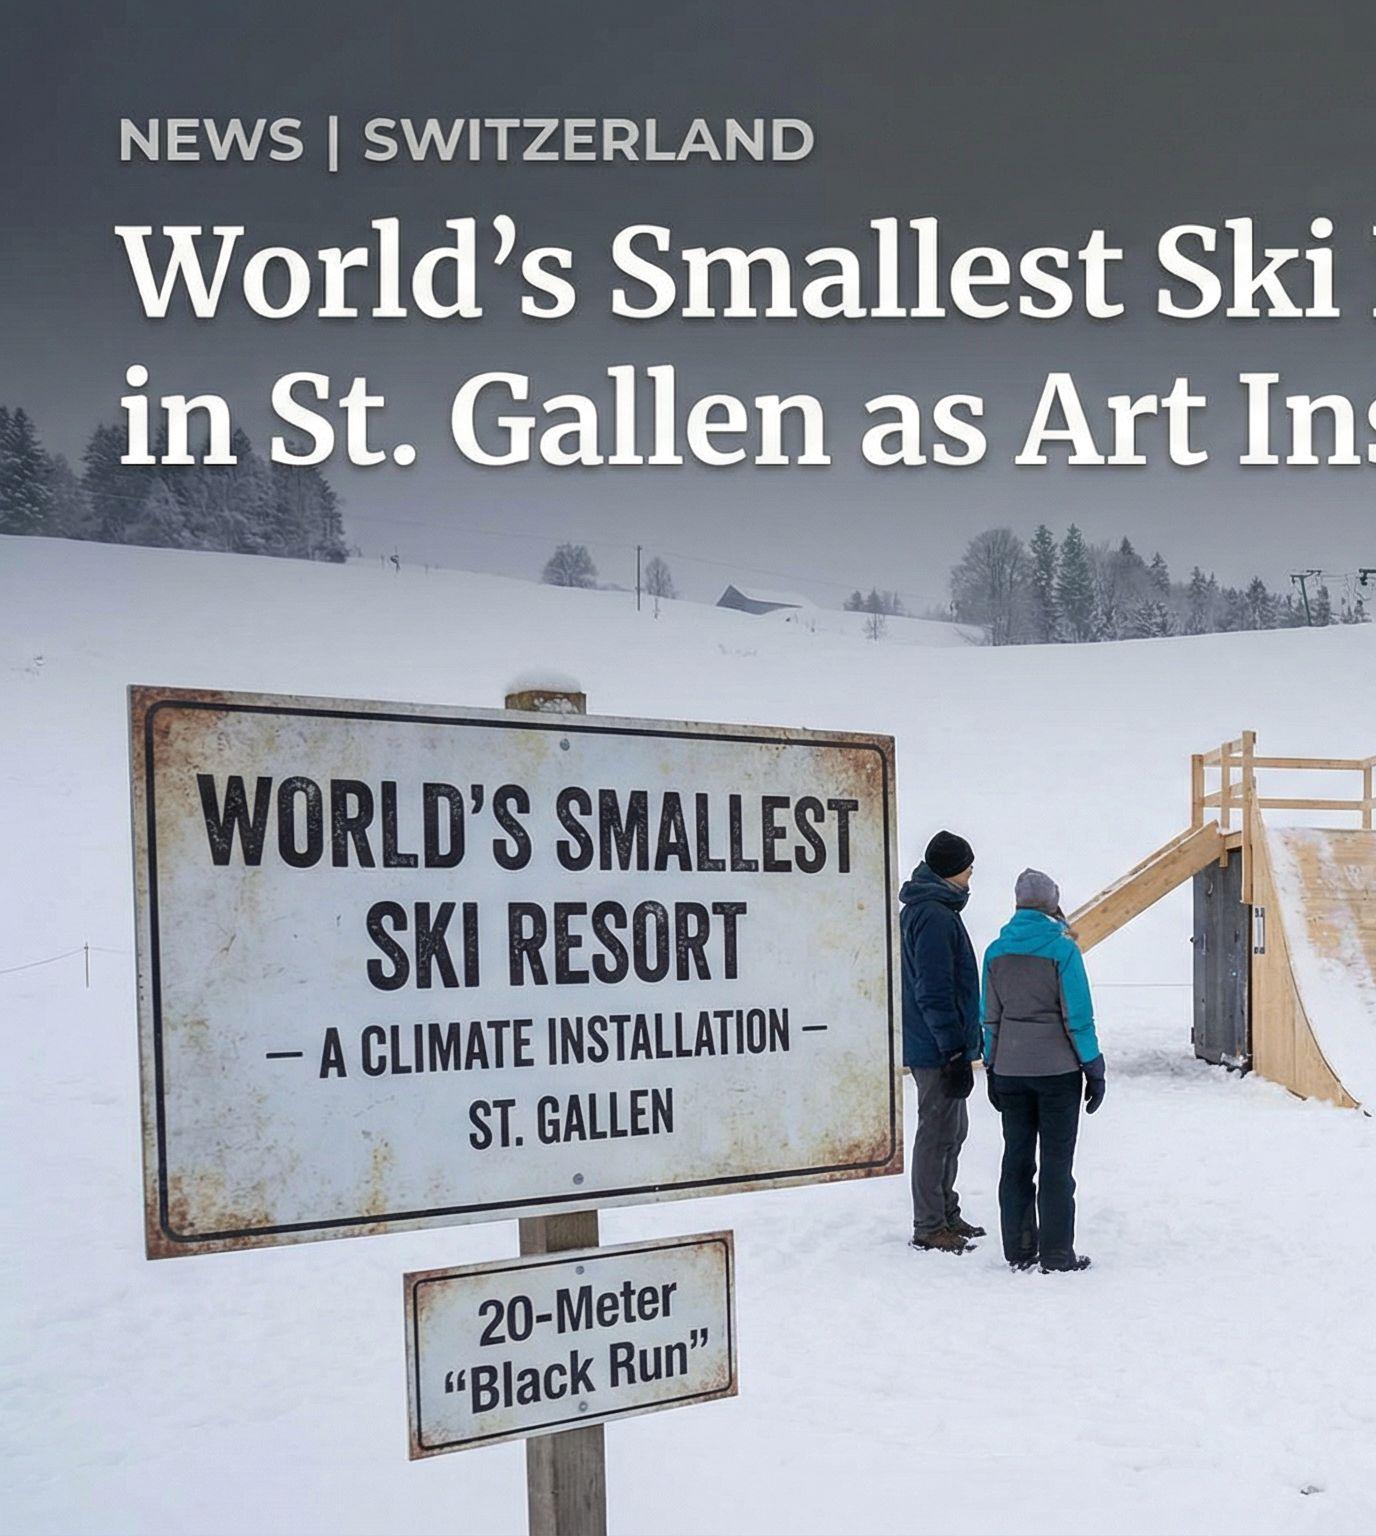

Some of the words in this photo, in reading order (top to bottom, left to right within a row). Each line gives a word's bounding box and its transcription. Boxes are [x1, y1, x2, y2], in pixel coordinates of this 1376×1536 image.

[196, 772, 533, 872] WORLD’S
[555, 786, 860, 875] SMALLEST
[365, 899, 481, 992] SKI
[507, 899, 748, 987] RESORT
[318, 1026, 348, 1080] A
[360, 1018, 535, 1078] CLIMATE
[547, 1007, 791, 1067] INSTALLATION
[468, 1097, 524, 1152] ST.
[536, 1087, 675, 1146] GALLEN
[477, 1280, 677, 1347] 20-Meter
[444, 1350, 596, 1415] “Black
[609, 1327, 709, 1388] Run”
